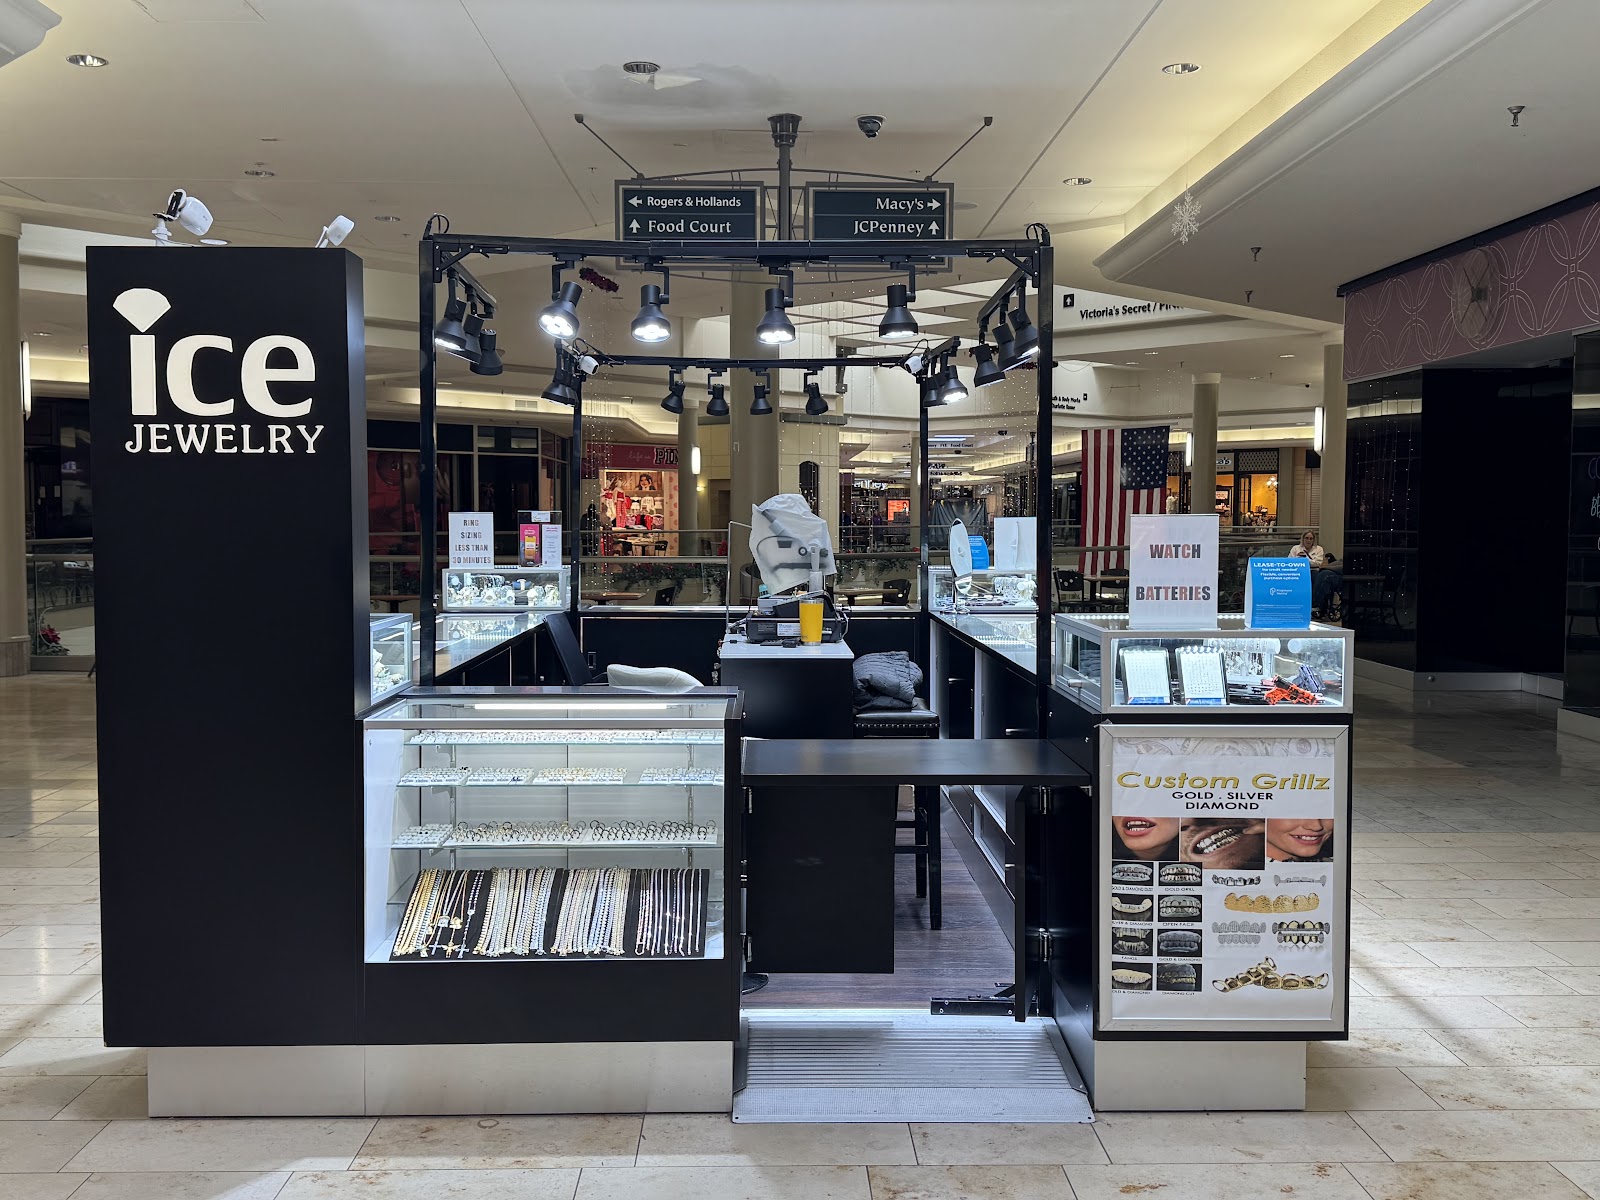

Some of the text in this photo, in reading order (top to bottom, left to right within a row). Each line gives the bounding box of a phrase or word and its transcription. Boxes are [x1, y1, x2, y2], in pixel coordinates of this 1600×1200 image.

[647, 196, 741, 208] Rogers & Hollands
[876, 198, 924, 212] Macy's
[648, 219, 732, 233] Food Court
[853, 220, 924, 236] JCPenney
[1080, 305, 1119, 319] Victoria's
[1122, 302, 1151, 315] Secret
[112, 287, 316, 418] ice
[125, 423, 325, 454] JEWELRY
[654, 447, 679, 465] PIN
[463, 519, 479, 527] RING
[1150, 544, 1201, 559] WATCH
[452, 556, 492, 564] 30 MINUTES
[1136, 585, 1211, 601] BATTERIES
[1116, 771, 1331, 790] Custom Grillz
[1172, 791, 1214, 800] GOLD
[1227, 792, 1274, 800] SILVER
[1185, 801, 1260, 810] DIAMOND
